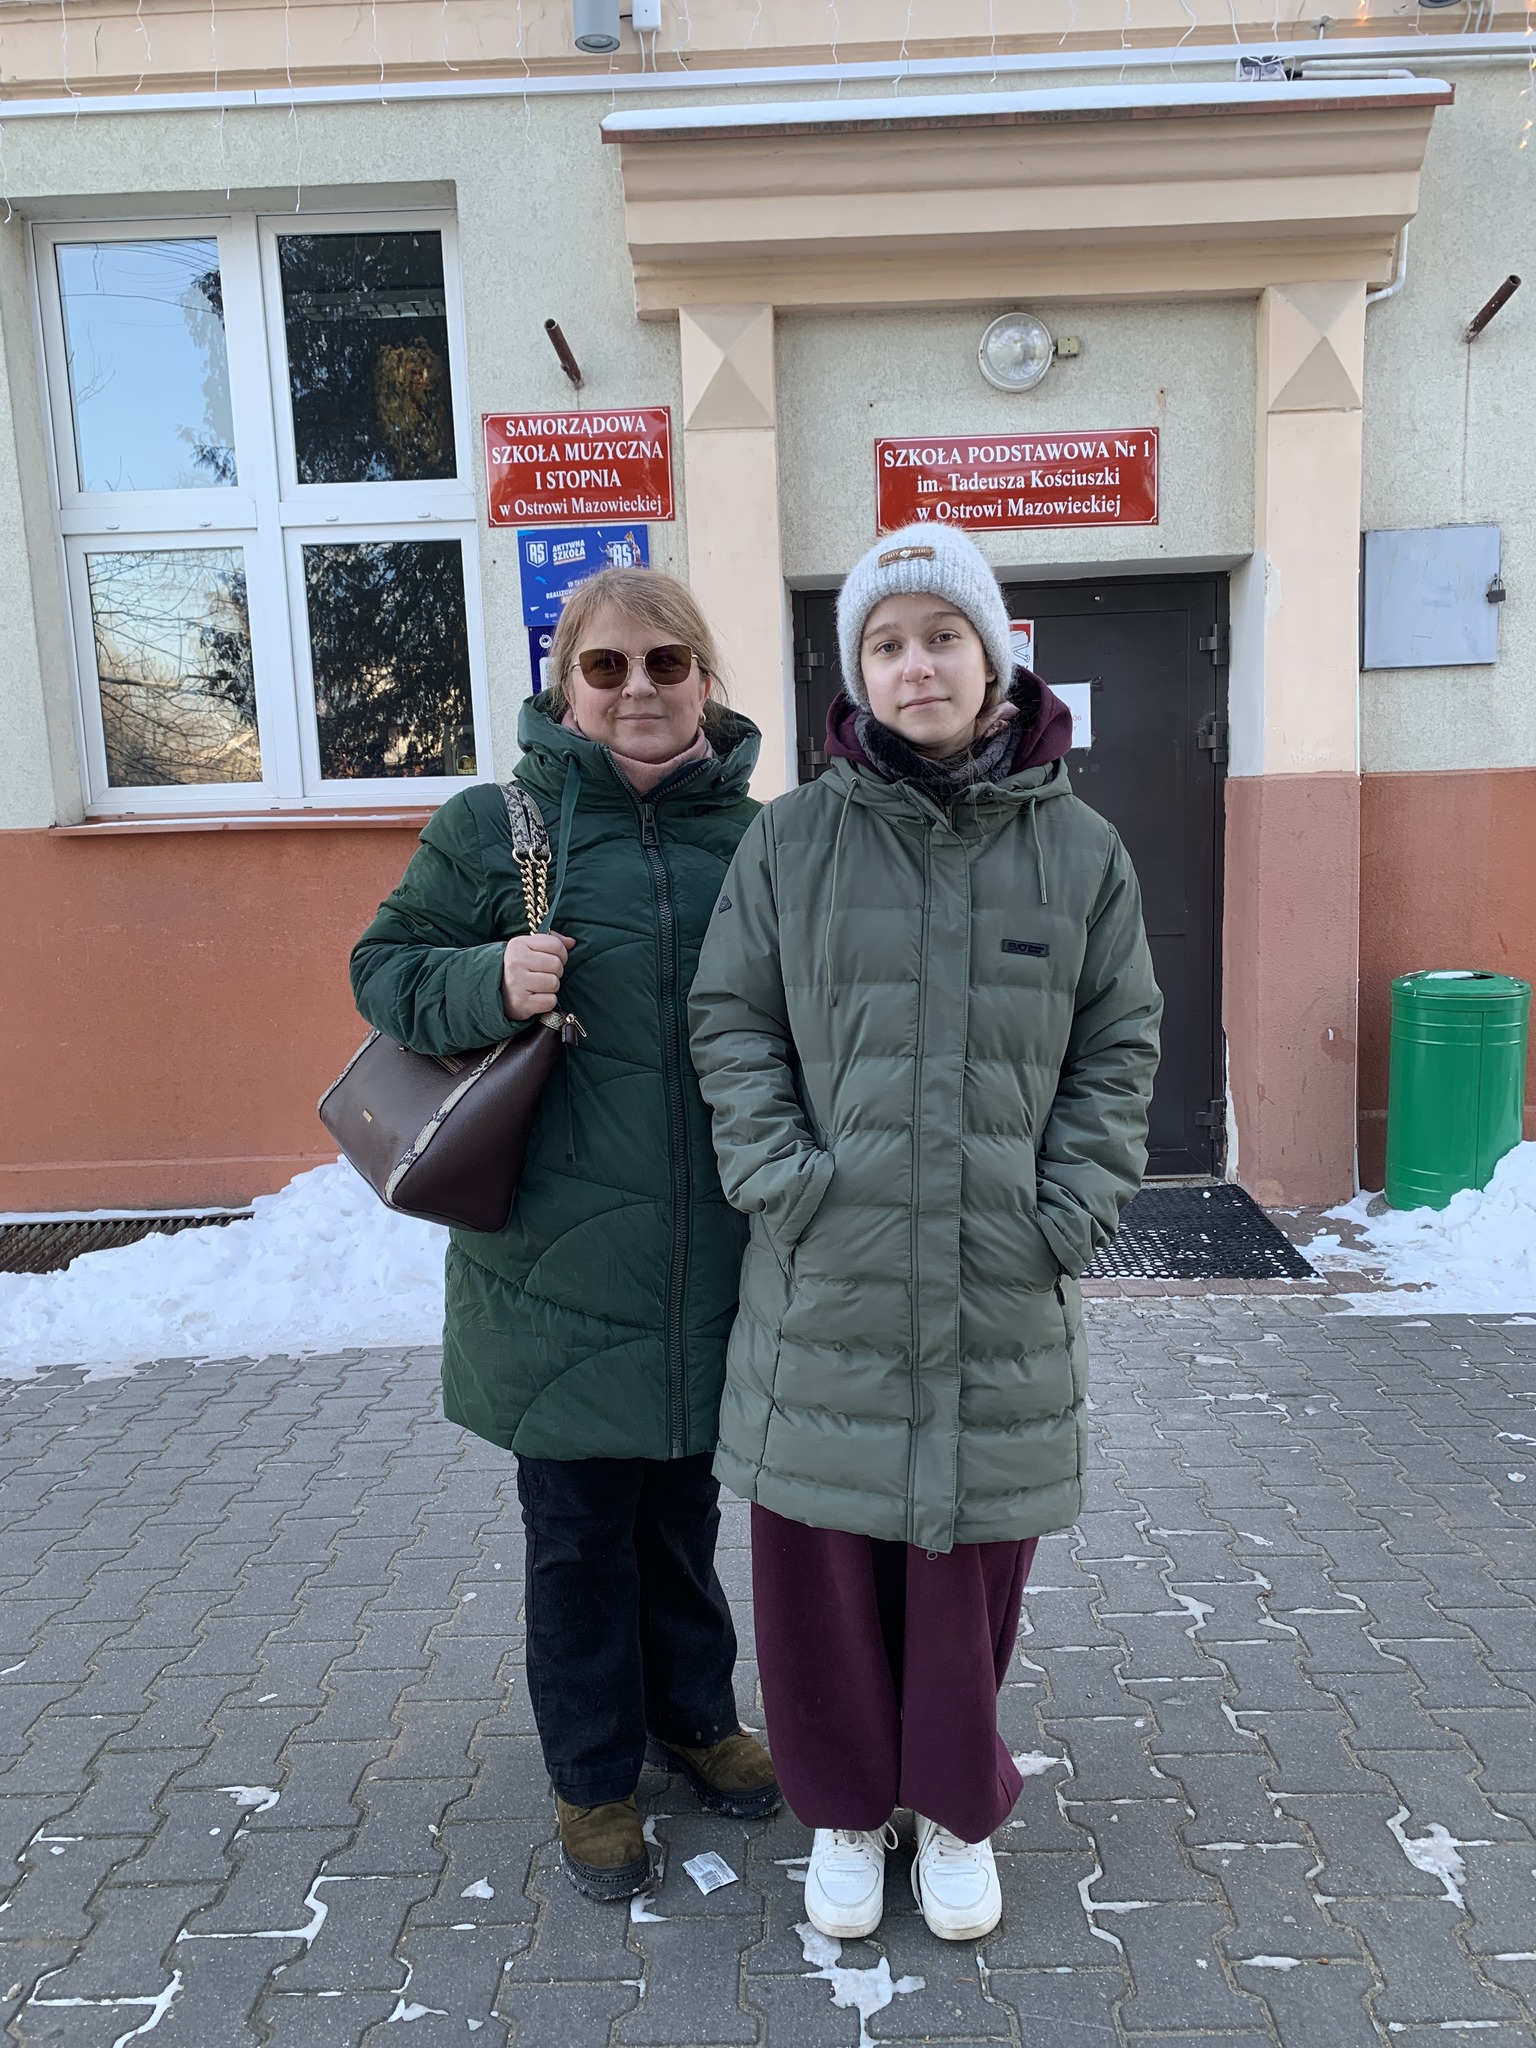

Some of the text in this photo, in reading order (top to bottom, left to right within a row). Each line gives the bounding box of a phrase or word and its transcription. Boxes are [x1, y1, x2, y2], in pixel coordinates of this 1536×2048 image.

[505, 415, 647, 438] SAMORZĄDOWA
[492, 440, 664, 464] SZKOŁA MUZYCZNA
[884, 440, 1150, 467] SZKOŁA PODSTAWOWA Nr 1
[535, 469, 622, 490] I STOPNIA
[917, 467, 1120, 493] im. Tadeusza Kościuszki
[499, 494, 662, 516] w Ostrowi Mazowieckiej
[916, 495, 1121, 520] w Ostrowi Mazowieckiej
[552, 539, 585, 553] AKTYWNA
[552, 546, 586, 561] SZKOŁA
